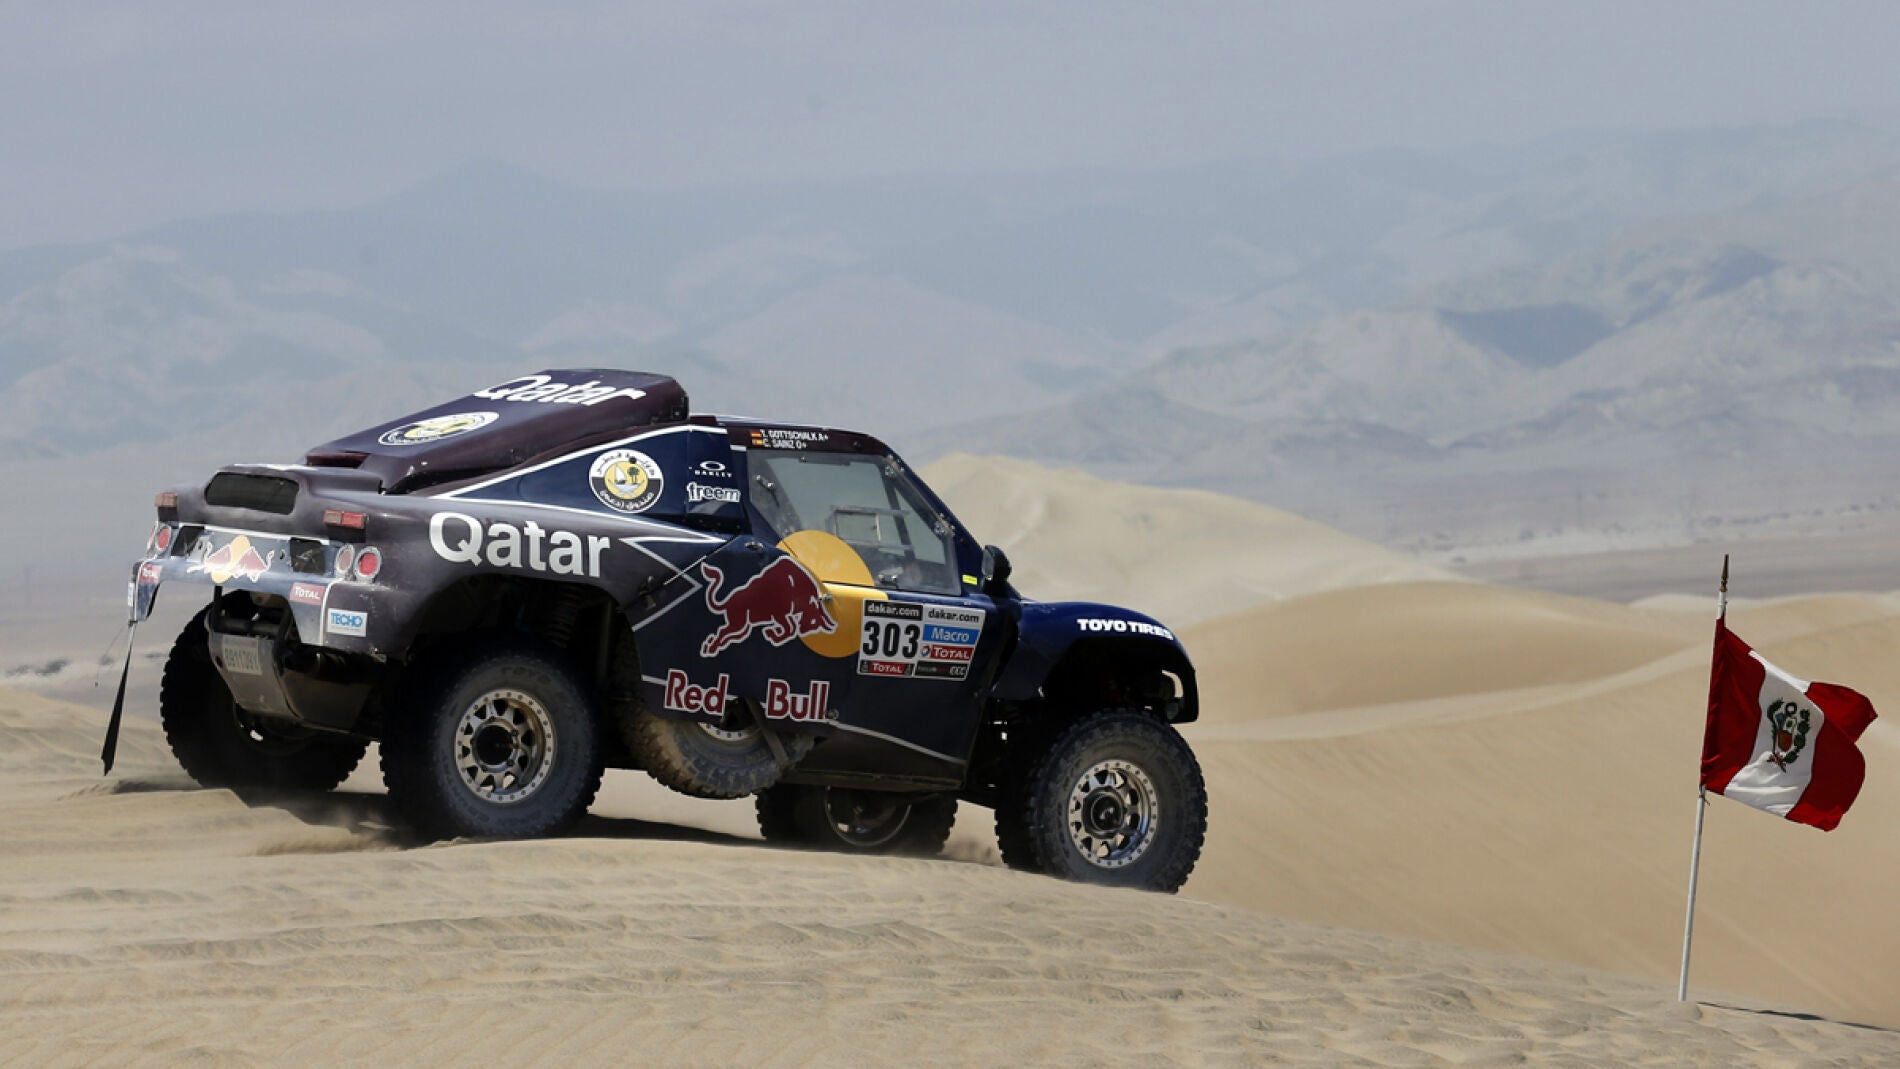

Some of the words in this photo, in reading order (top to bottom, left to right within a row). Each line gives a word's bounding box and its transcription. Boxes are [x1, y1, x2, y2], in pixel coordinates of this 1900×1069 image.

[473, 375, 646, 406] Qatar
[686, 481, 741, 502] freem
[429, 511, 611, 578] Qatar
[294, 587, 321, 600] TOTAL
[867, 603, 919, 617] dakar.com
[928, 609, 979, 623] dakar.com
[331, 612, 363, 628] TECHO
[931, 626, 970, 642] Macro
[1077, 618, 1127, 632] TOYO
[1127, 621, 1174, 641] TIRES
[862, 620, 920, 659] 303
[932, 647, 970, 660] TOTAL
[872, 662, 904, 674] TOTAL
[665, 669, 729, 716] Red
[766, 679, 829, 722] Bull
